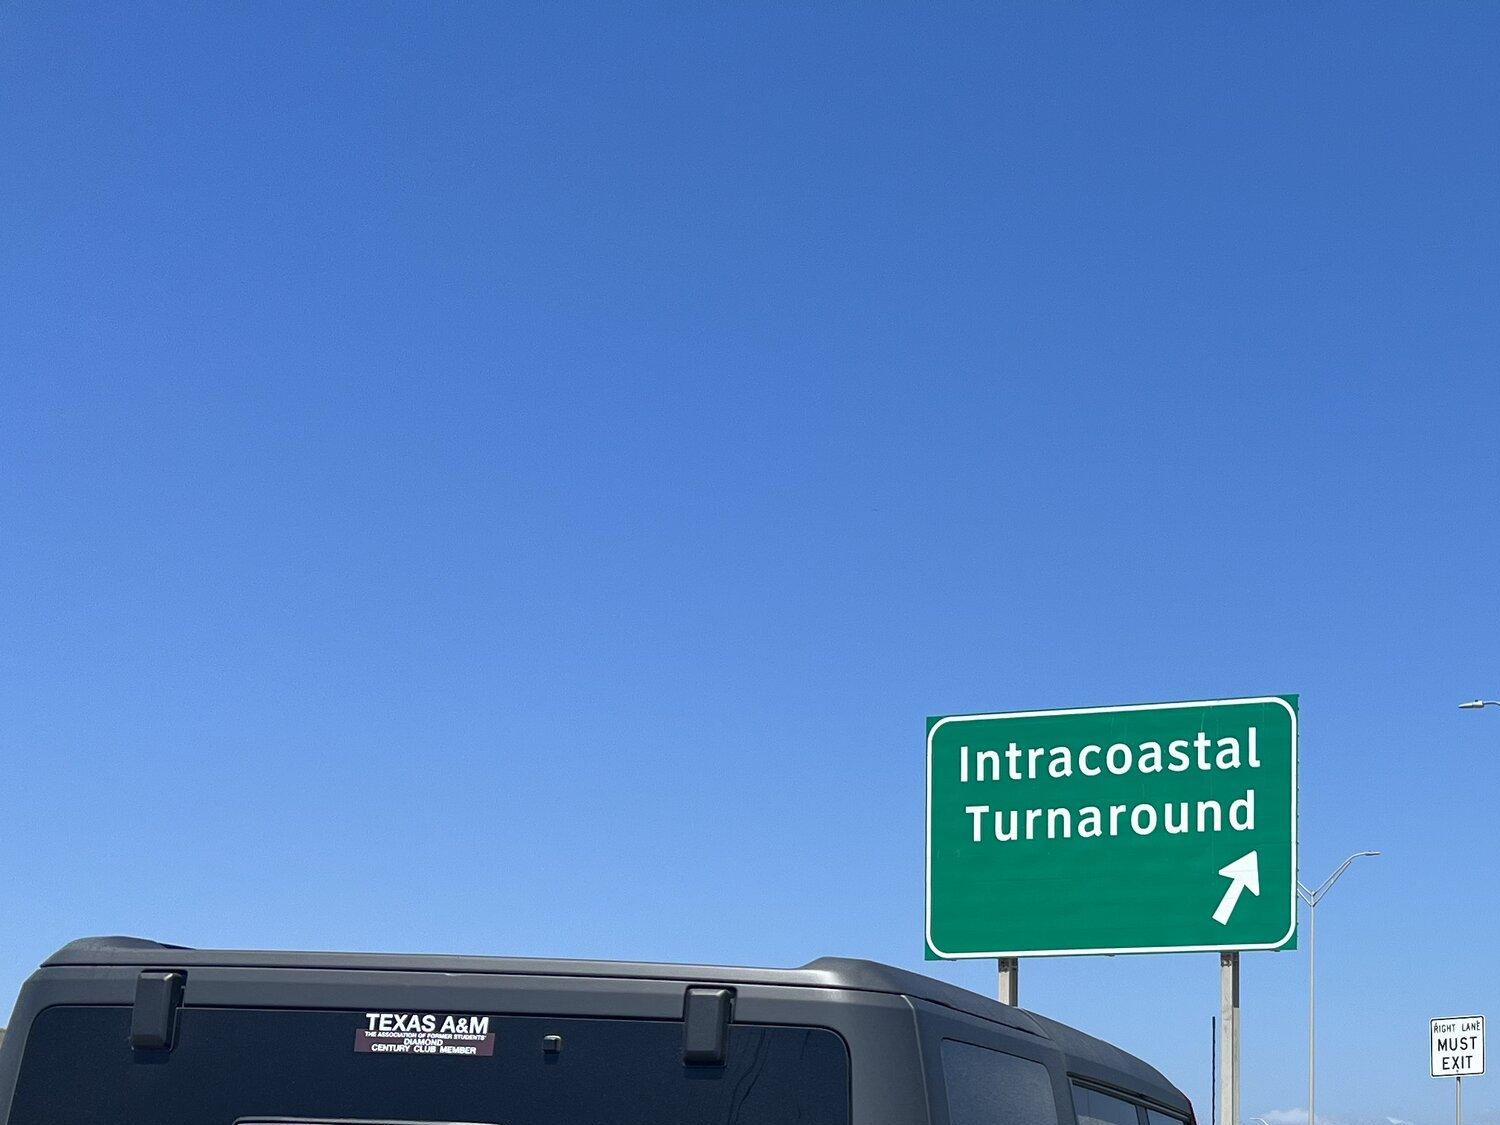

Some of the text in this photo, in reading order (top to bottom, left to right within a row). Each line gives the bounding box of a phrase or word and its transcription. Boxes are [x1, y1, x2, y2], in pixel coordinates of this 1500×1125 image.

[960, 727, 1261, 783] Intracoastal
[966, 789, 1255, 842] Turnaround
[366, 1013, 489, 1034] TEXAS A&M
[1434, 1020, 1480, 1033] RIGHT LANE
[371, 1044, 477, 1054] CENTURY CLUB MEMBER
[404, 1038, 443, 1046] DIAMOND
[1438, 1036, 1477, 1051] MUST
[1442, 1055, 1473, 1070] EXIT
